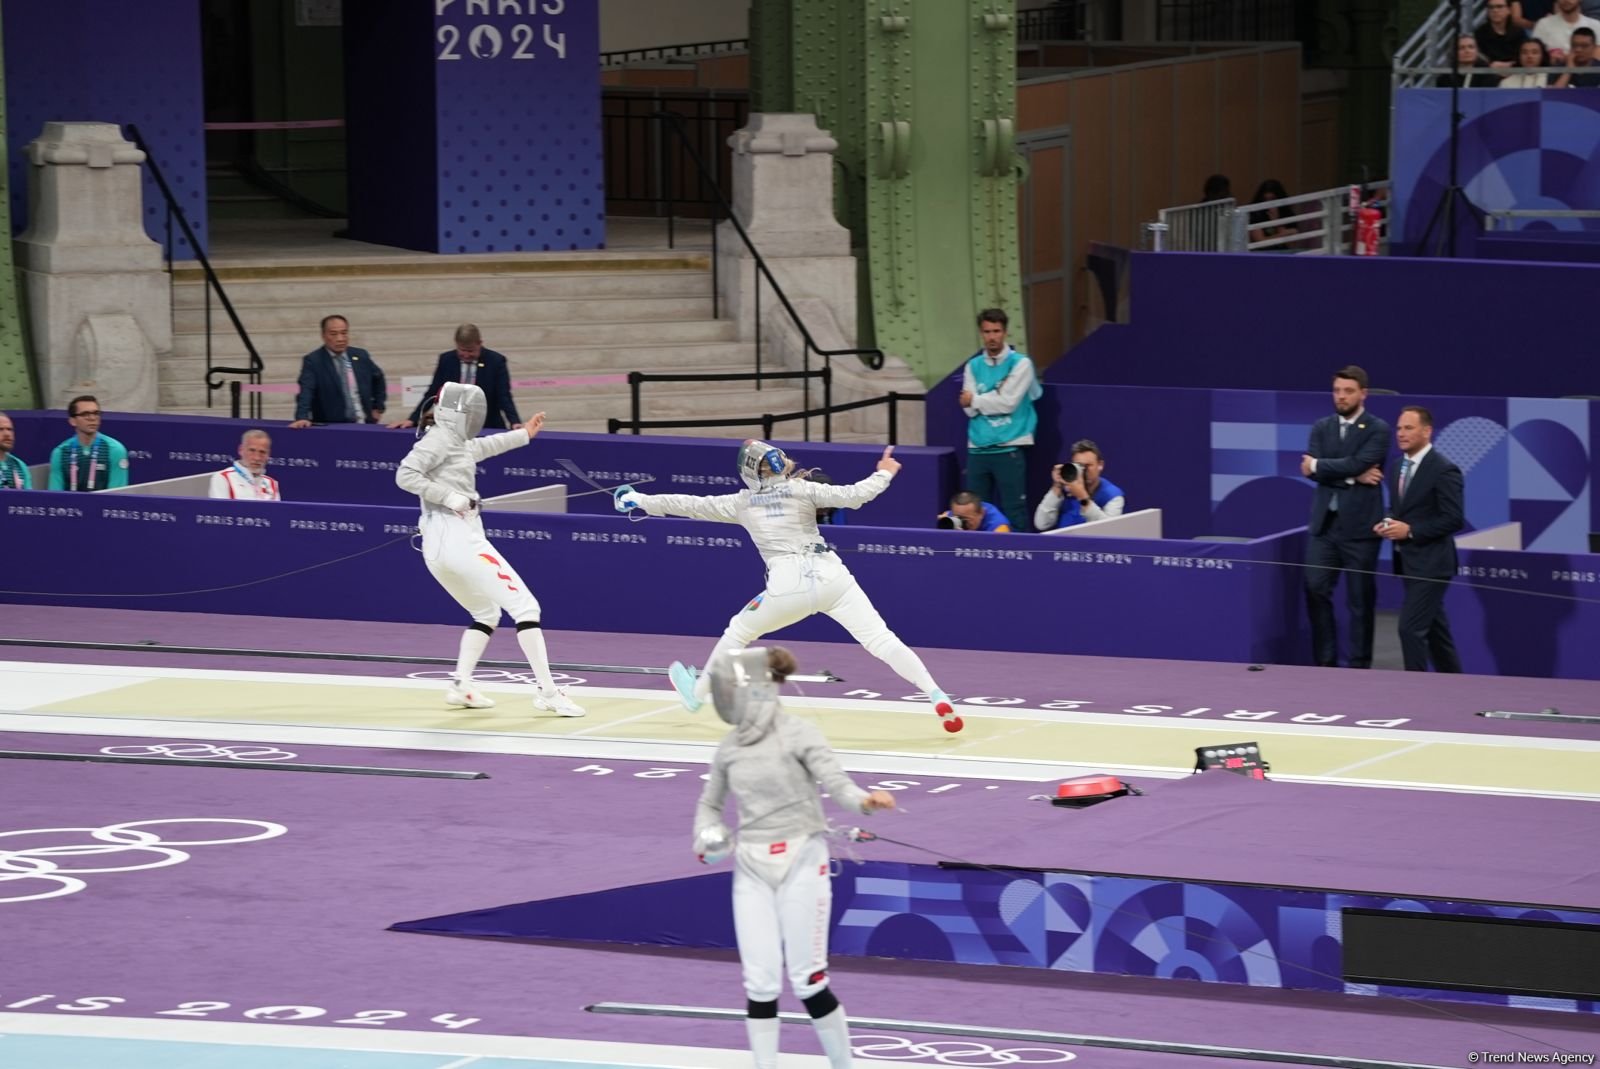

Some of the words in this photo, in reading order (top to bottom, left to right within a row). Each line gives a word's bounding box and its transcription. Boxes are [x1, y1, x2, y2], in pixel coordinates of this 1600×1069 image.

[436, 24, 566, 60] 2024
[128, 450, 152, 459] 024
[288, 458, 320, 468] 2024
[539, 468, 571, 478] 2024
[707, 475, 739, 486] 2024
[48, 507, 83, 518] 2024
[142, 511, 177, 522] 2024
[236, 516, 271, 528] 2024
[329, 521, 365, 533] 2024
[485, 528, 516, 540] ARIS
[517, 530, 552, 542] 2024
[611, 533, 647, 545] 2024
[706, 537, 742, 549] 2024
[897, 545, 935, 557] 2024
[996, 549, 1033, 561] 2024
[1095, 553, 1133, 565] 2024
[1195, 558, 1233, 570] 2024
[1488, 567, 1529, 580] 2024
[154, 1001, 482, 1029] 2024
